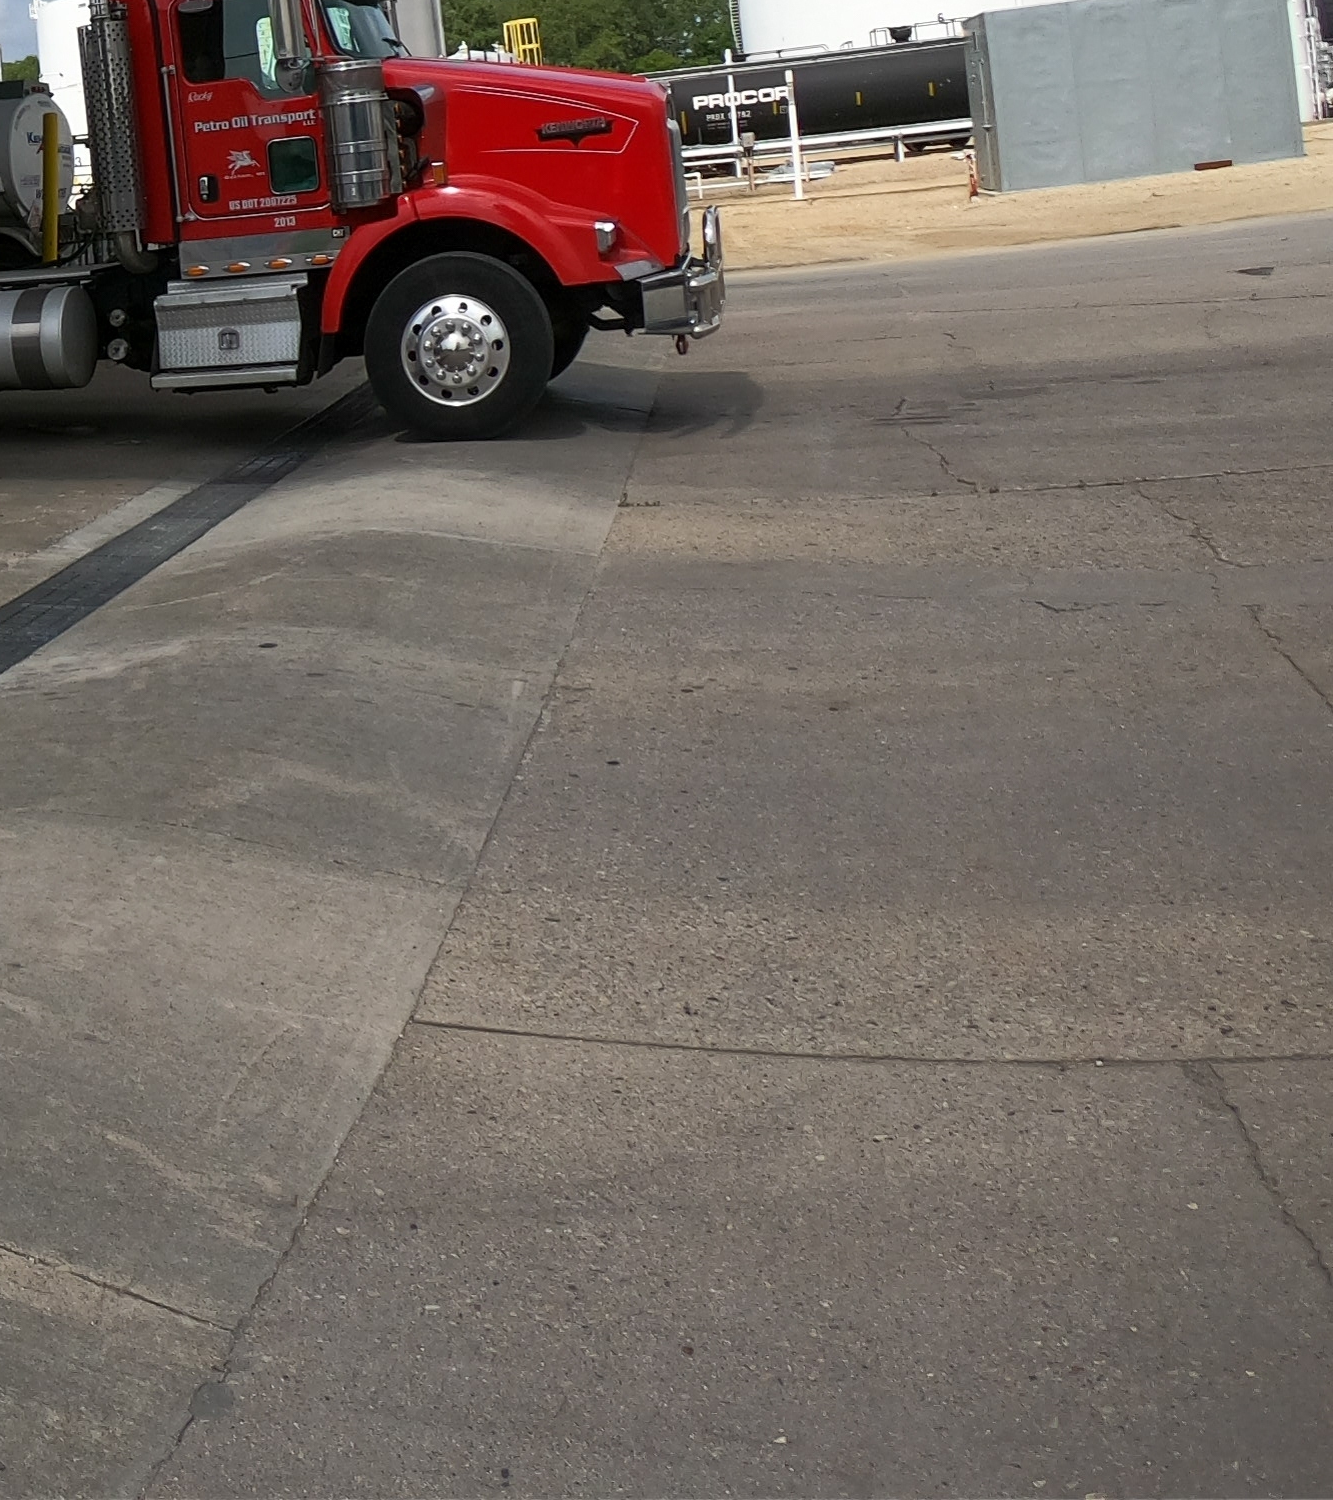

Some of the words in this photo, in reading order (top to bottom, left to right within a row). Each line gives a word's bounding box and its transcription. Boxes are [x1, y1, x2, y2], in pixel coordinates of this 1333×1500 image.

[194, 120, 230, 133] Petro
[232, 116, 248, 128] Oil
[250, 109, 317, 126] Transport
